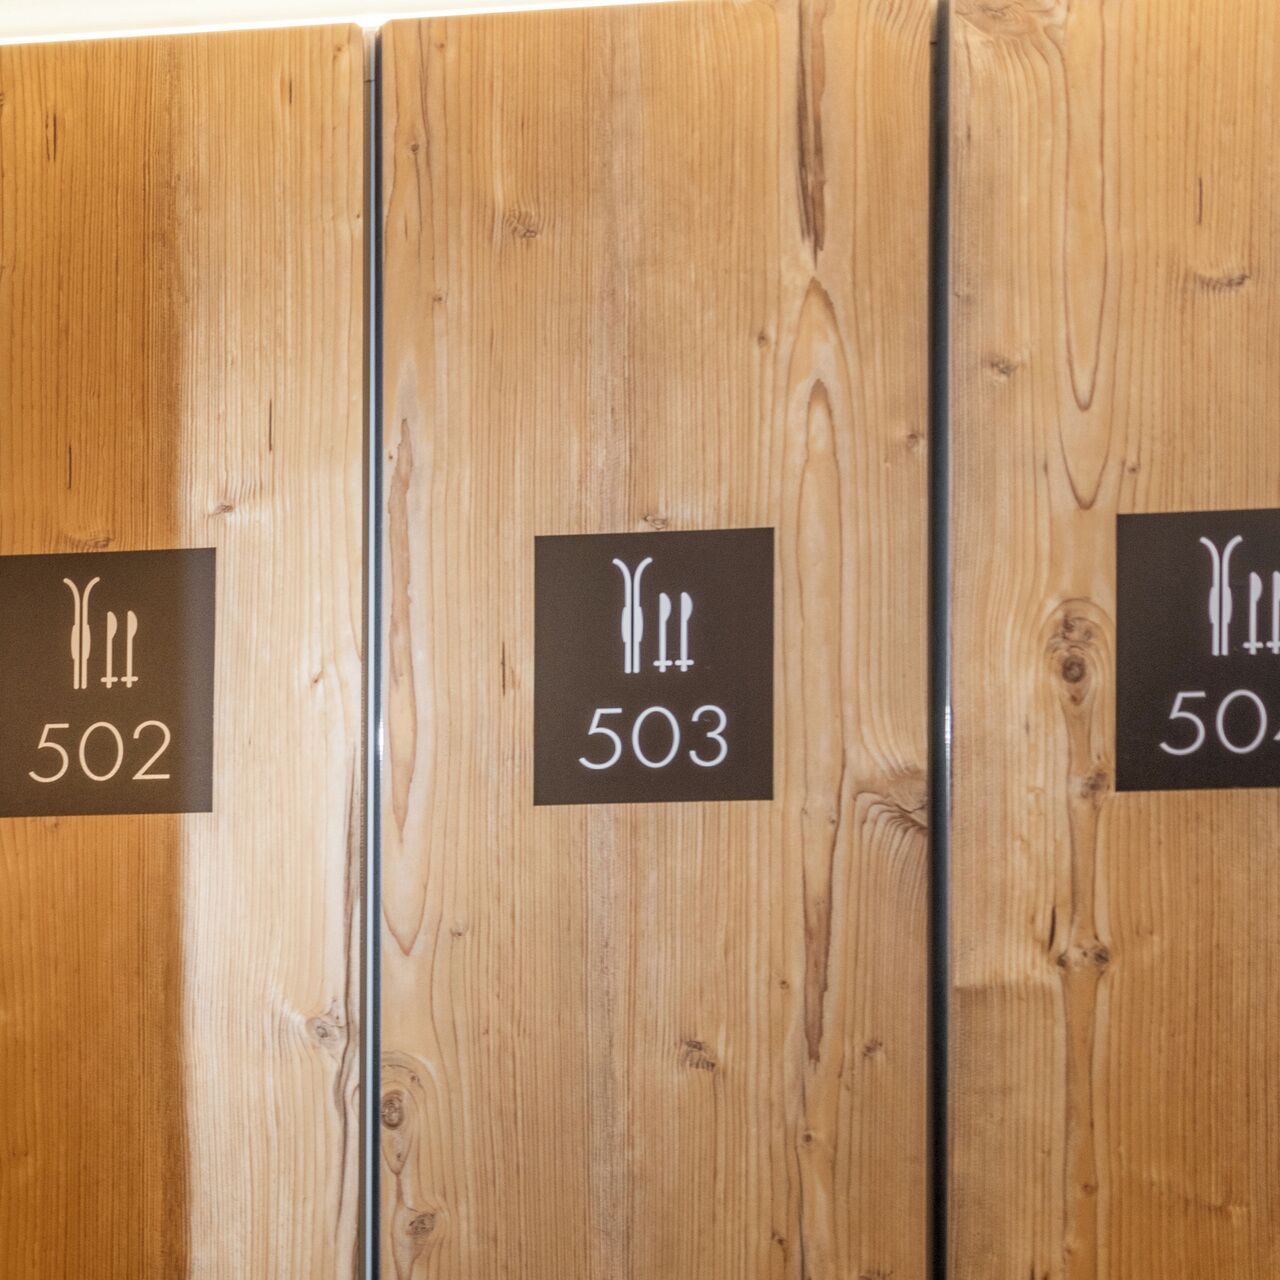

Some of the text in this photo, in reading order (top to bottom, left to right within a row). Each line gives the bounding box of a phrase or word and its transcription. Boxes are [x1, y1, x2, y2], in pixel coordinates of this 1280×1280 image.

[28, 719, 171, 783] 502
[578, 704, 729, 770] 503
[1158, 689, 1280, 756] 50
